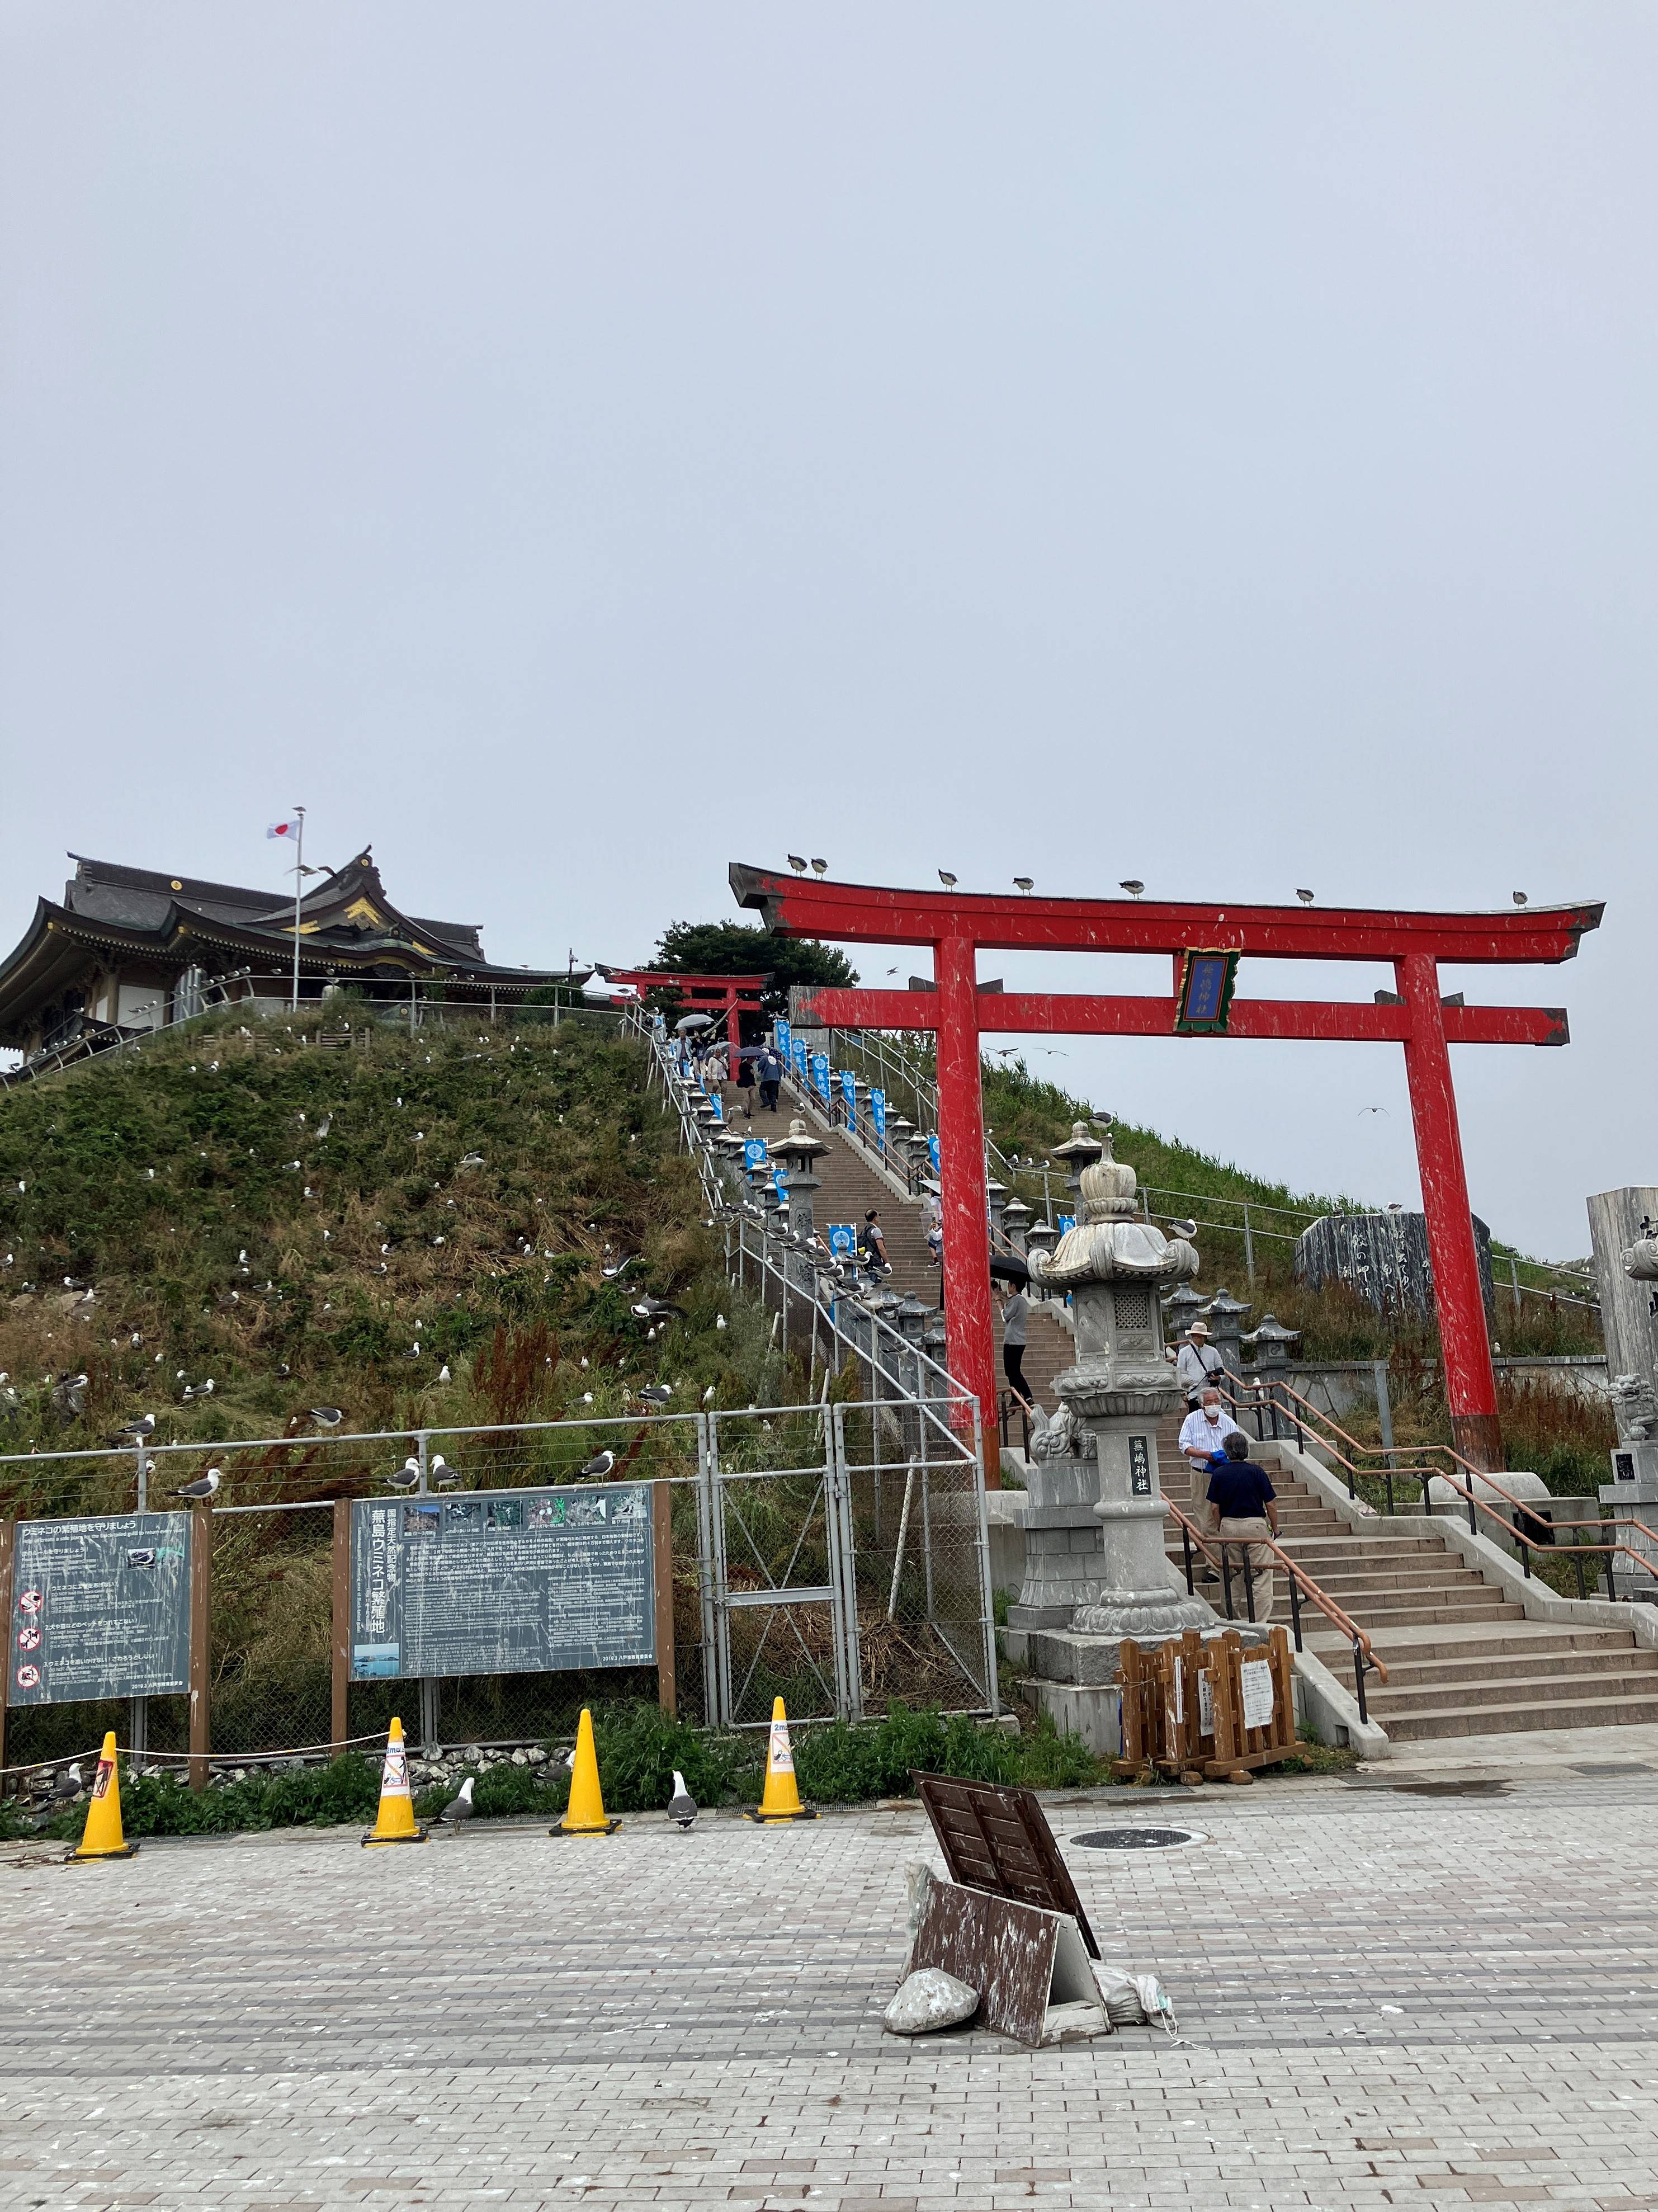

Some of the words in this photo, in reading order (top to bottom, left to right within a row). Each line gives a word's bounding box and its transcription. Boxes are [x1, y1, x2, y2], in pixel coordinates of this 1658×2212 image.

[371, 1510, 386, 1634] 蕪島ウミネコ繁殖地
[386, 1508, 396, 1583] 国指定天然記念物
